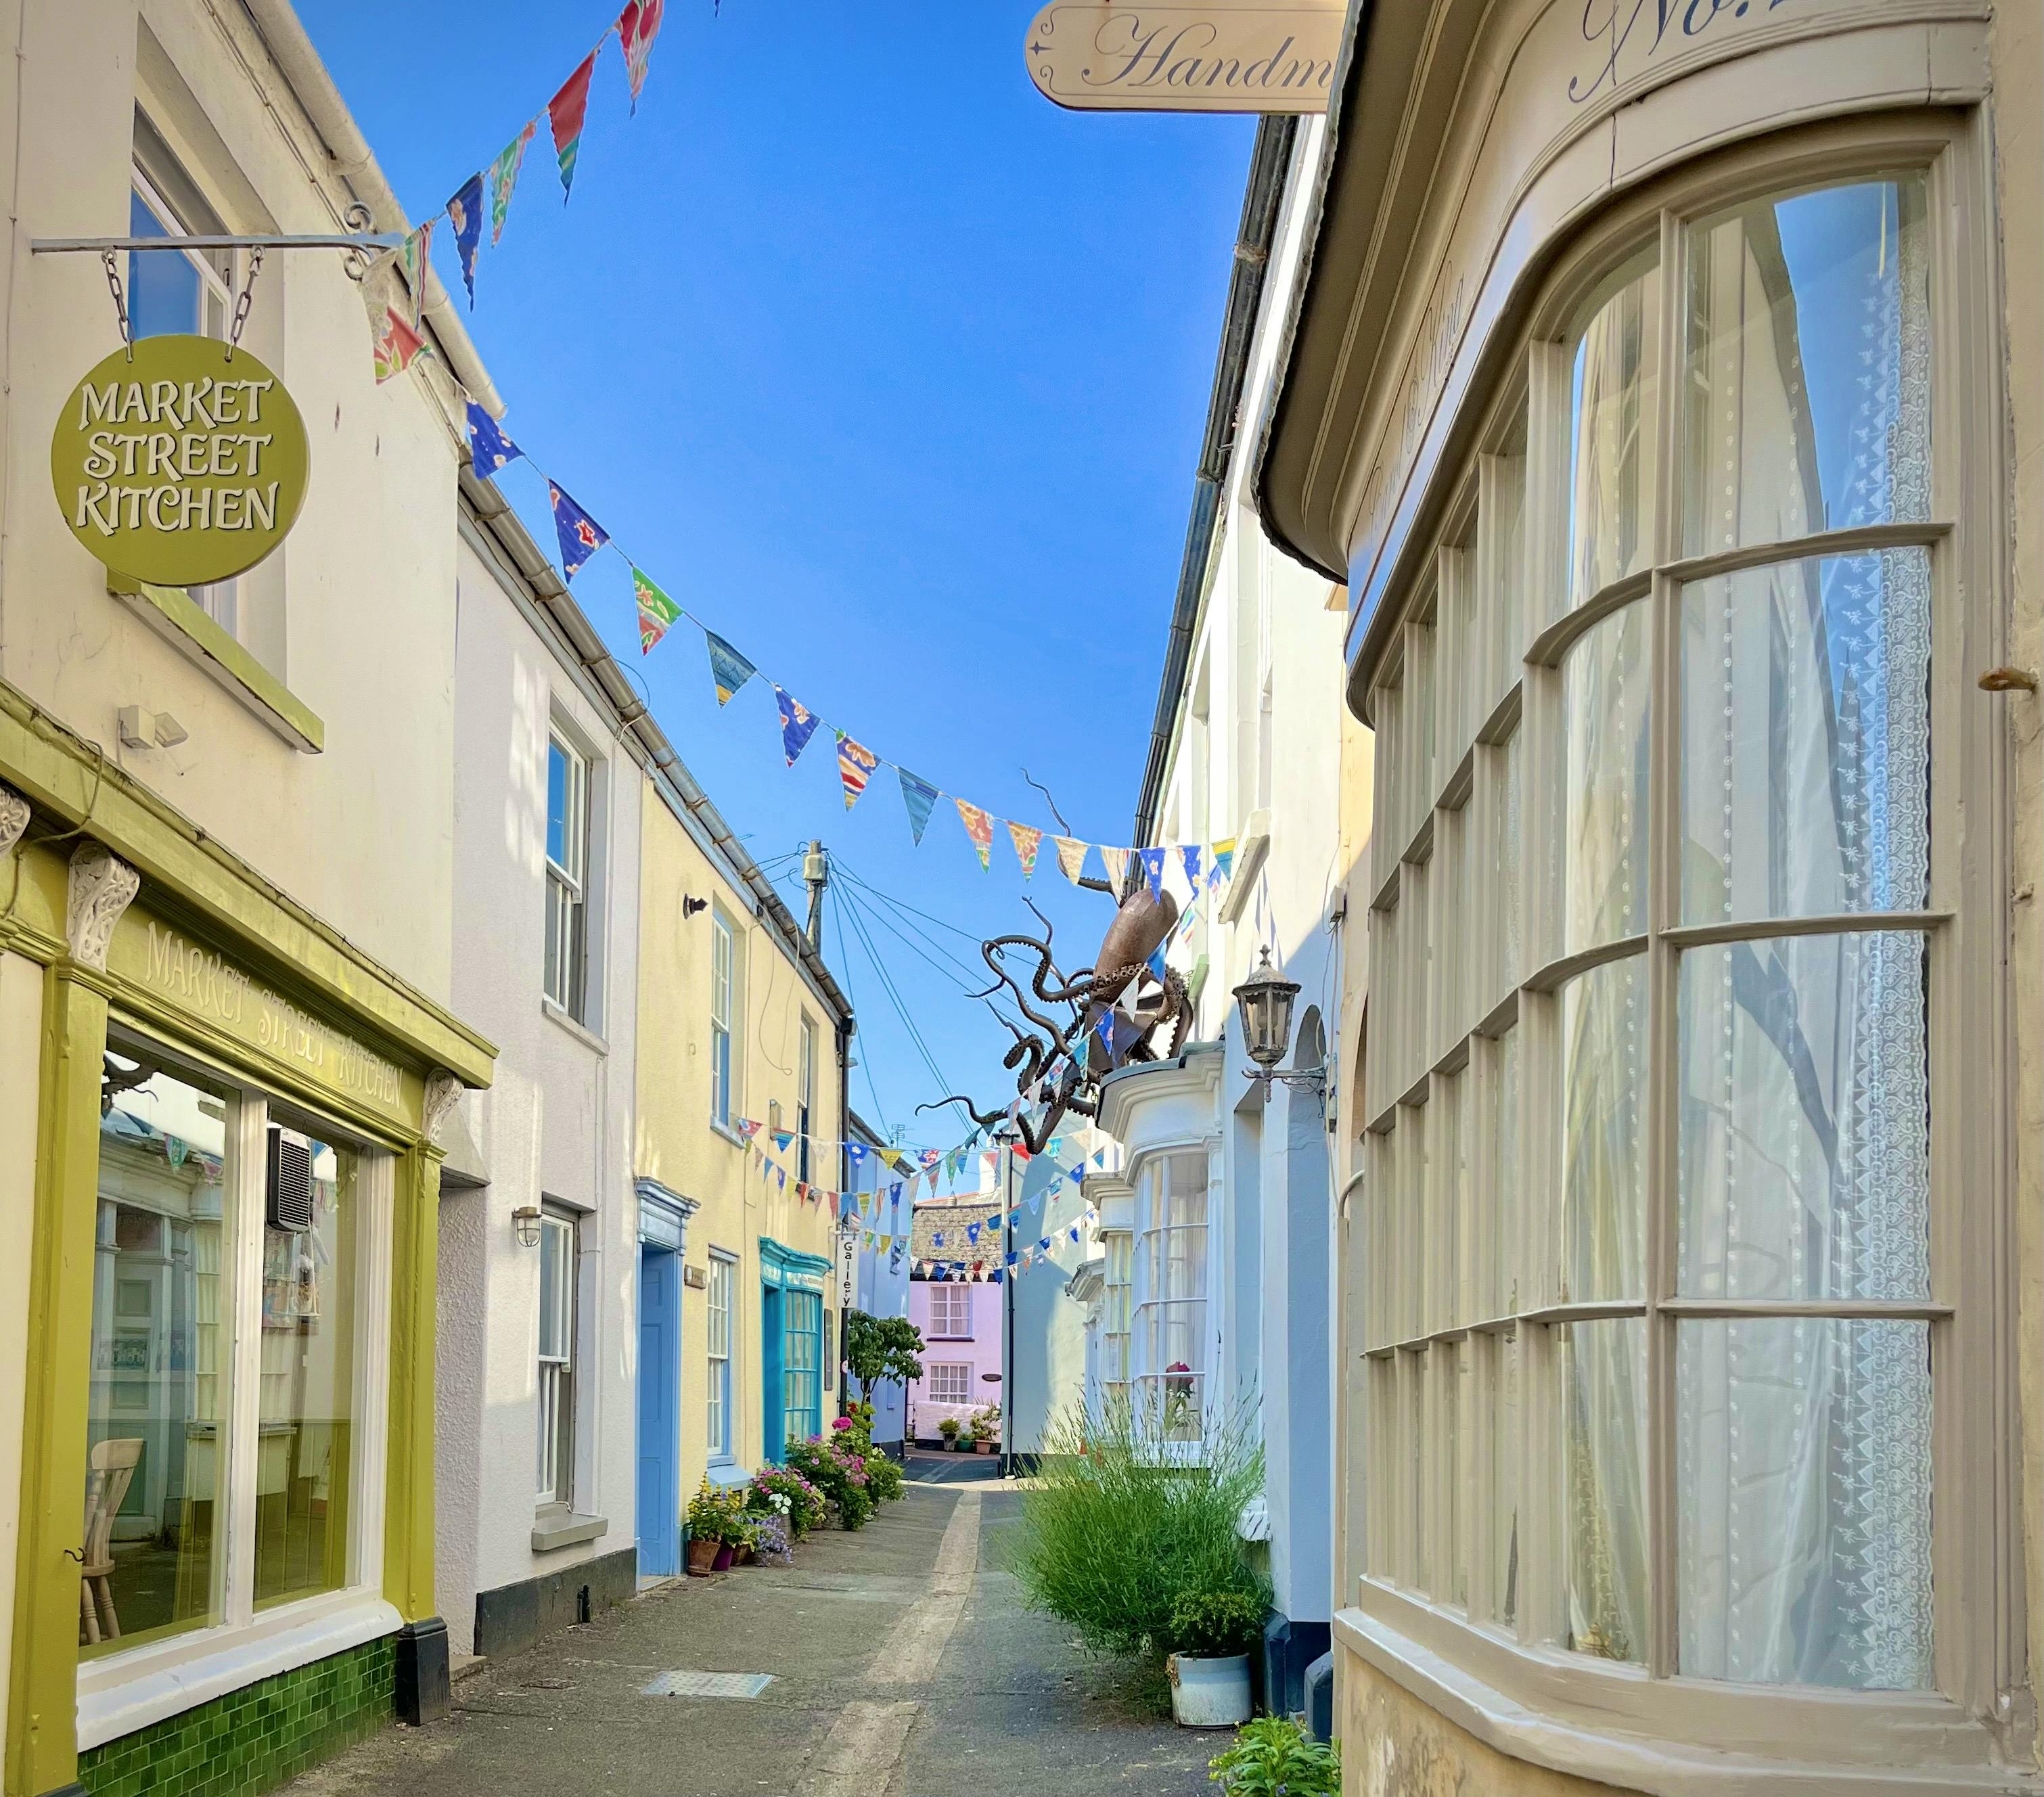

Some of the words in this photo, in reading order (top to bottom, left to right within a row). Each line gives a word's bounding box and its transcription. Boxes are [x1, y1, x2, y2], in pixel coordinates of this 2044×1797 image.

[78, 376, 273, 430] MARKET
[84, 431, 273, 482] STREET
[76, 481, 280, 536] KITCHEN
[145, 921, 250, 1024] MARKET
[257, 987, 330, 1068] STREET
[338, 1034, 406, 1109] KITCHEN
[843, 1242, 853, 1306] Gallery
